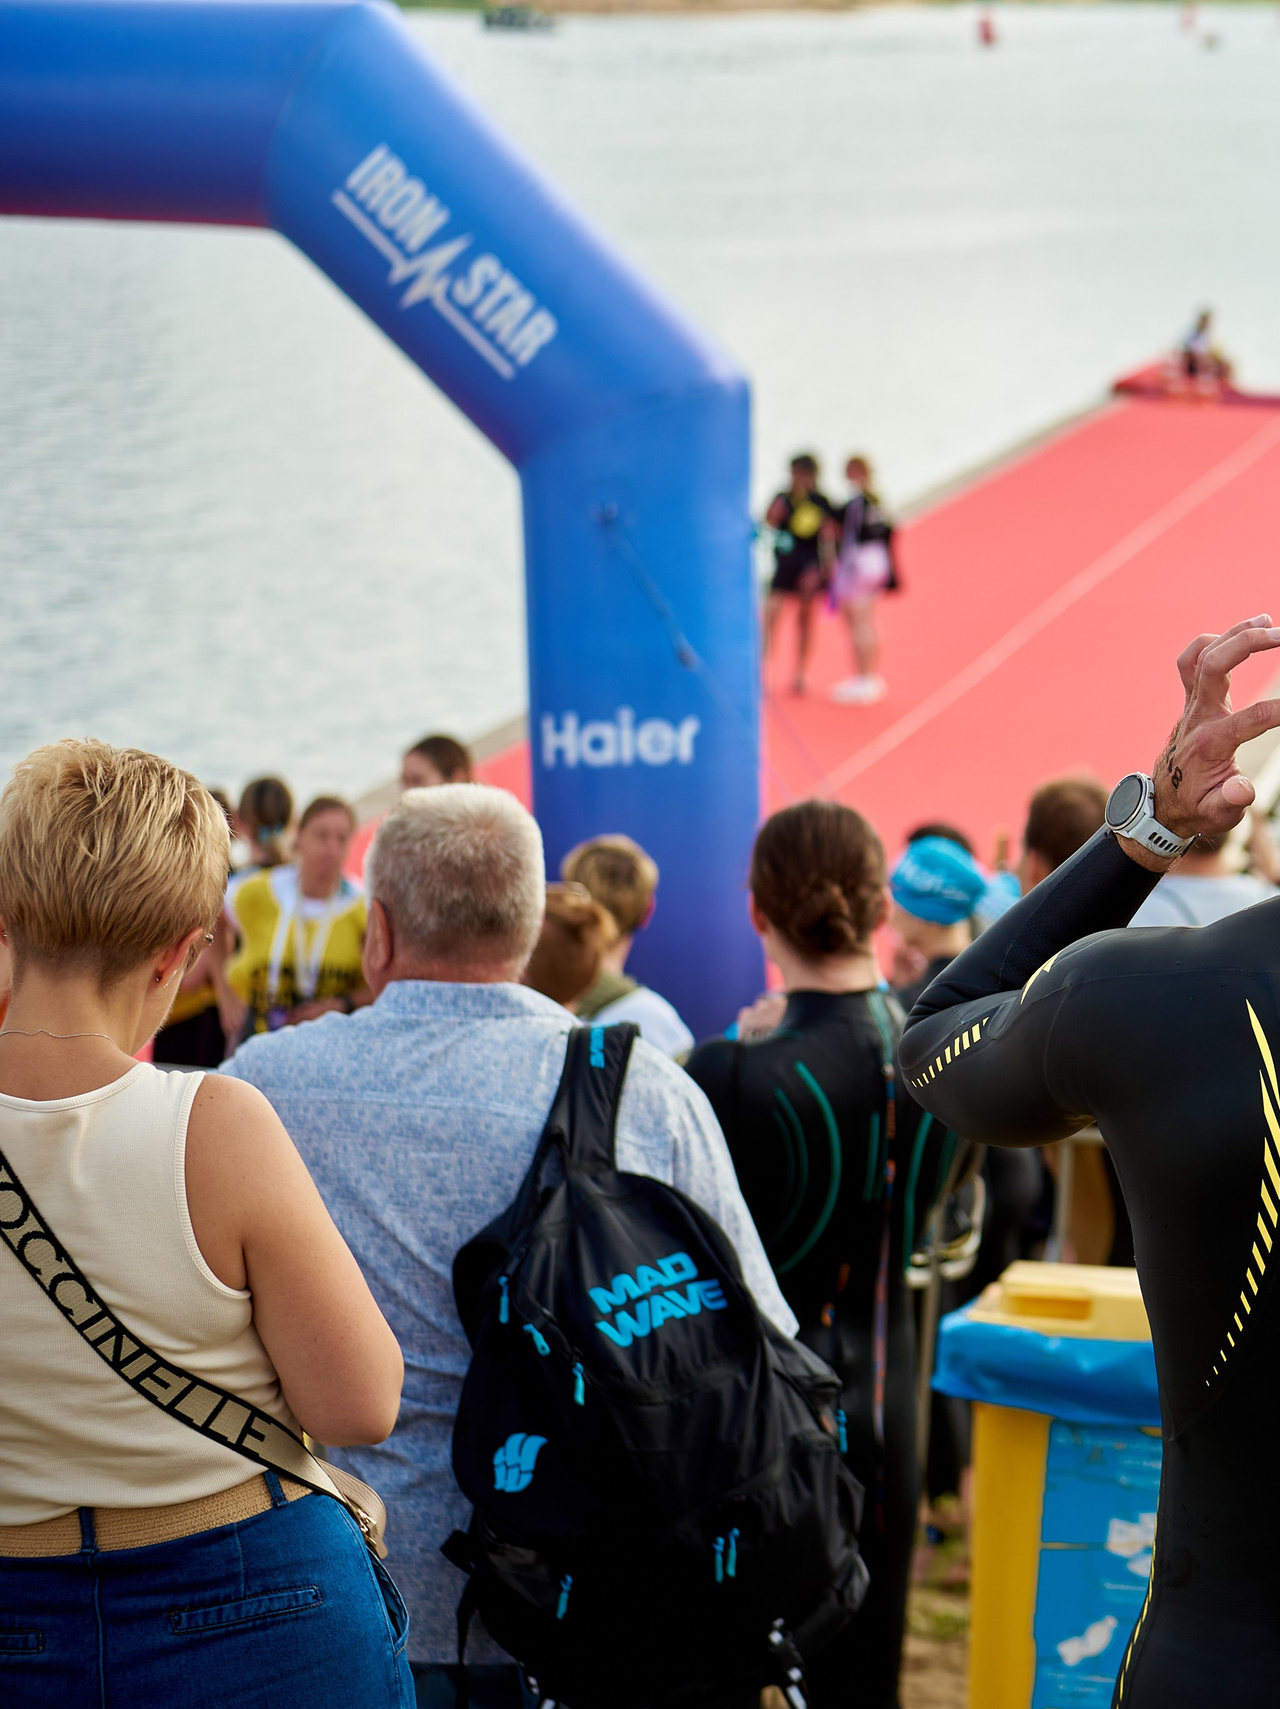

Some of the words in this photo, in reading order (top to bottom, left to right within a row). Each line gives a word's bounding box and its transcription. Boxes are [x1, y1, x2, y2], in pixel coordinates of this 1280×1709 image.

[345, 142, 450, 252] IRON
[453, 253, 560, 367] STAR
[541, 704, 701, 769] Haier
[588, 1252, 699, 1314] MAD
[594, 1278, 728, 1347] WAVE
